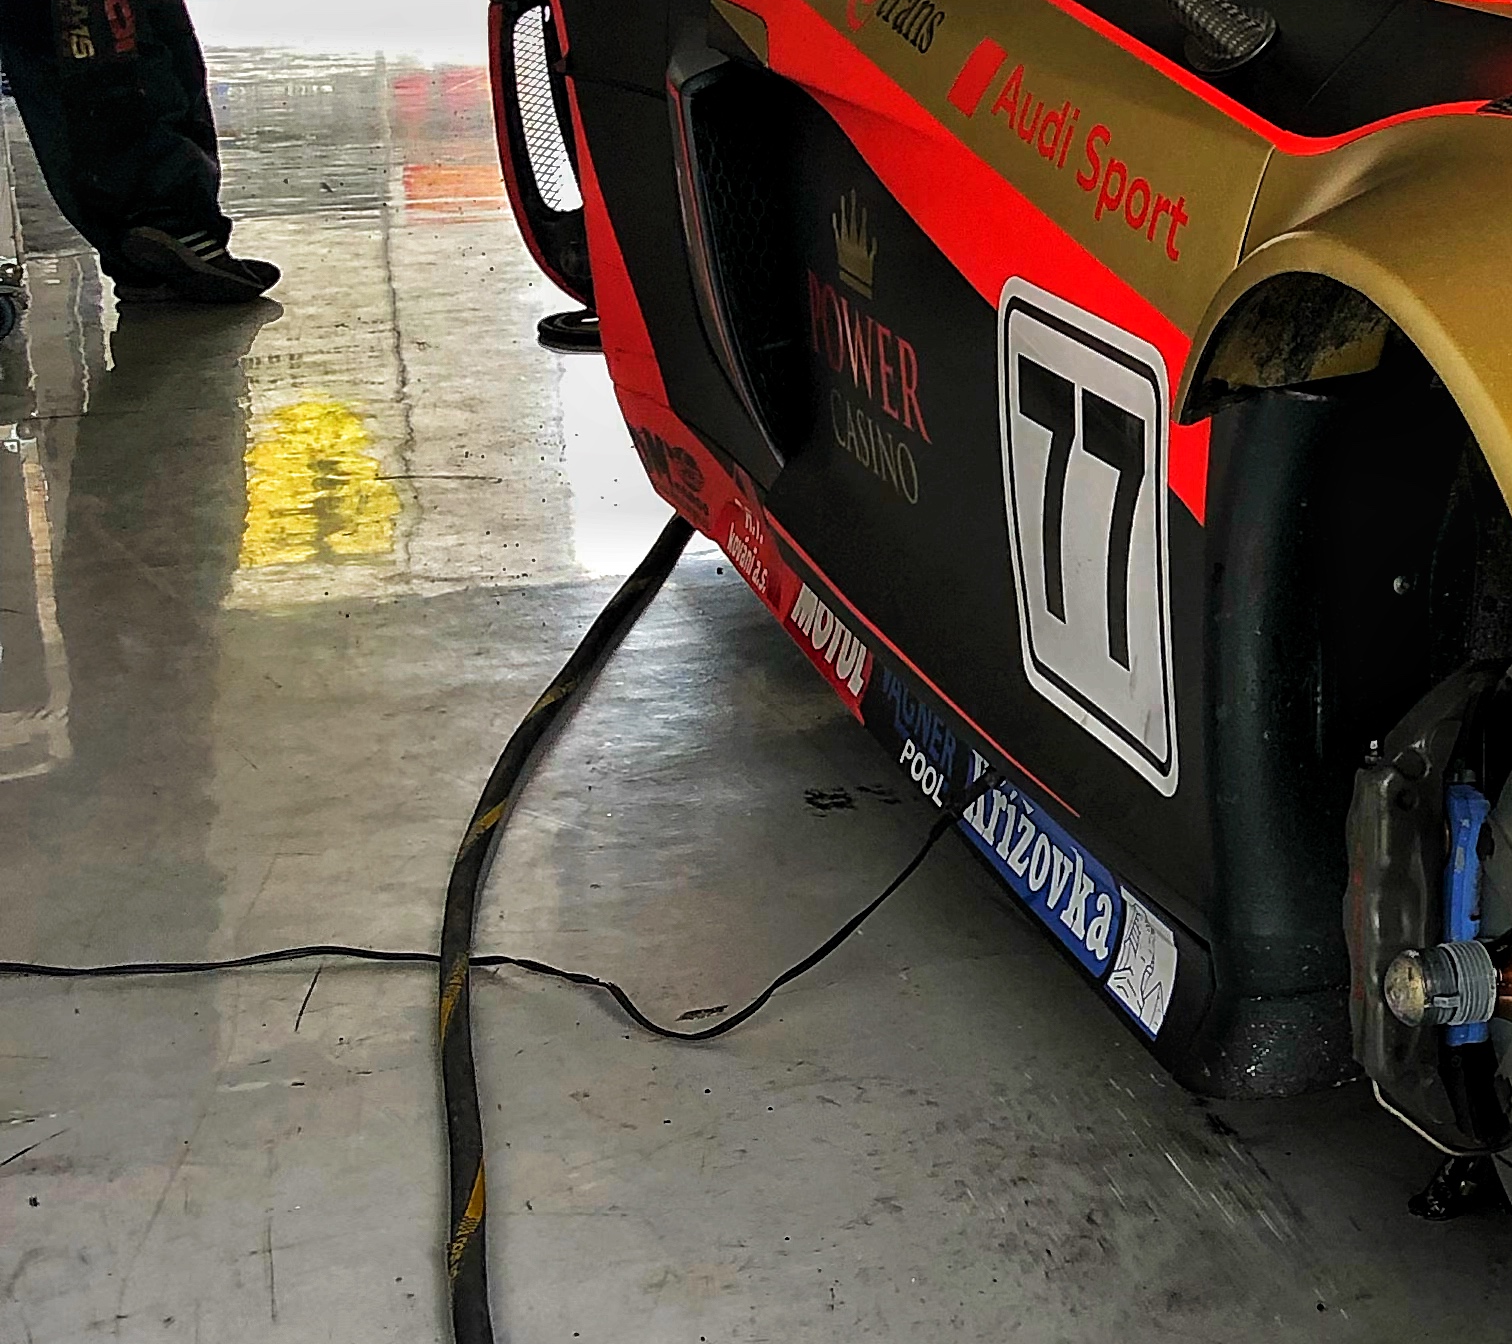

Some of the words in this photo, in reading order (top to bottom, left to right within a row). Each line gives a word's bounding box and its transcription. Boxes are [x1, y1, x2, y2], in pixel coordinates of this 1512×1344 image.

[990, 62, 1081, 171] Audi
[1075, 123, 1189, 263] Sport
[807, 267, 933, 446] POWER
[830, 388, 919, 505] CASINO
[1017, 352, 1146, 673] 77
[790, 581, 868, 698] MOTUL
[899, 738, 945, 808] POOL
